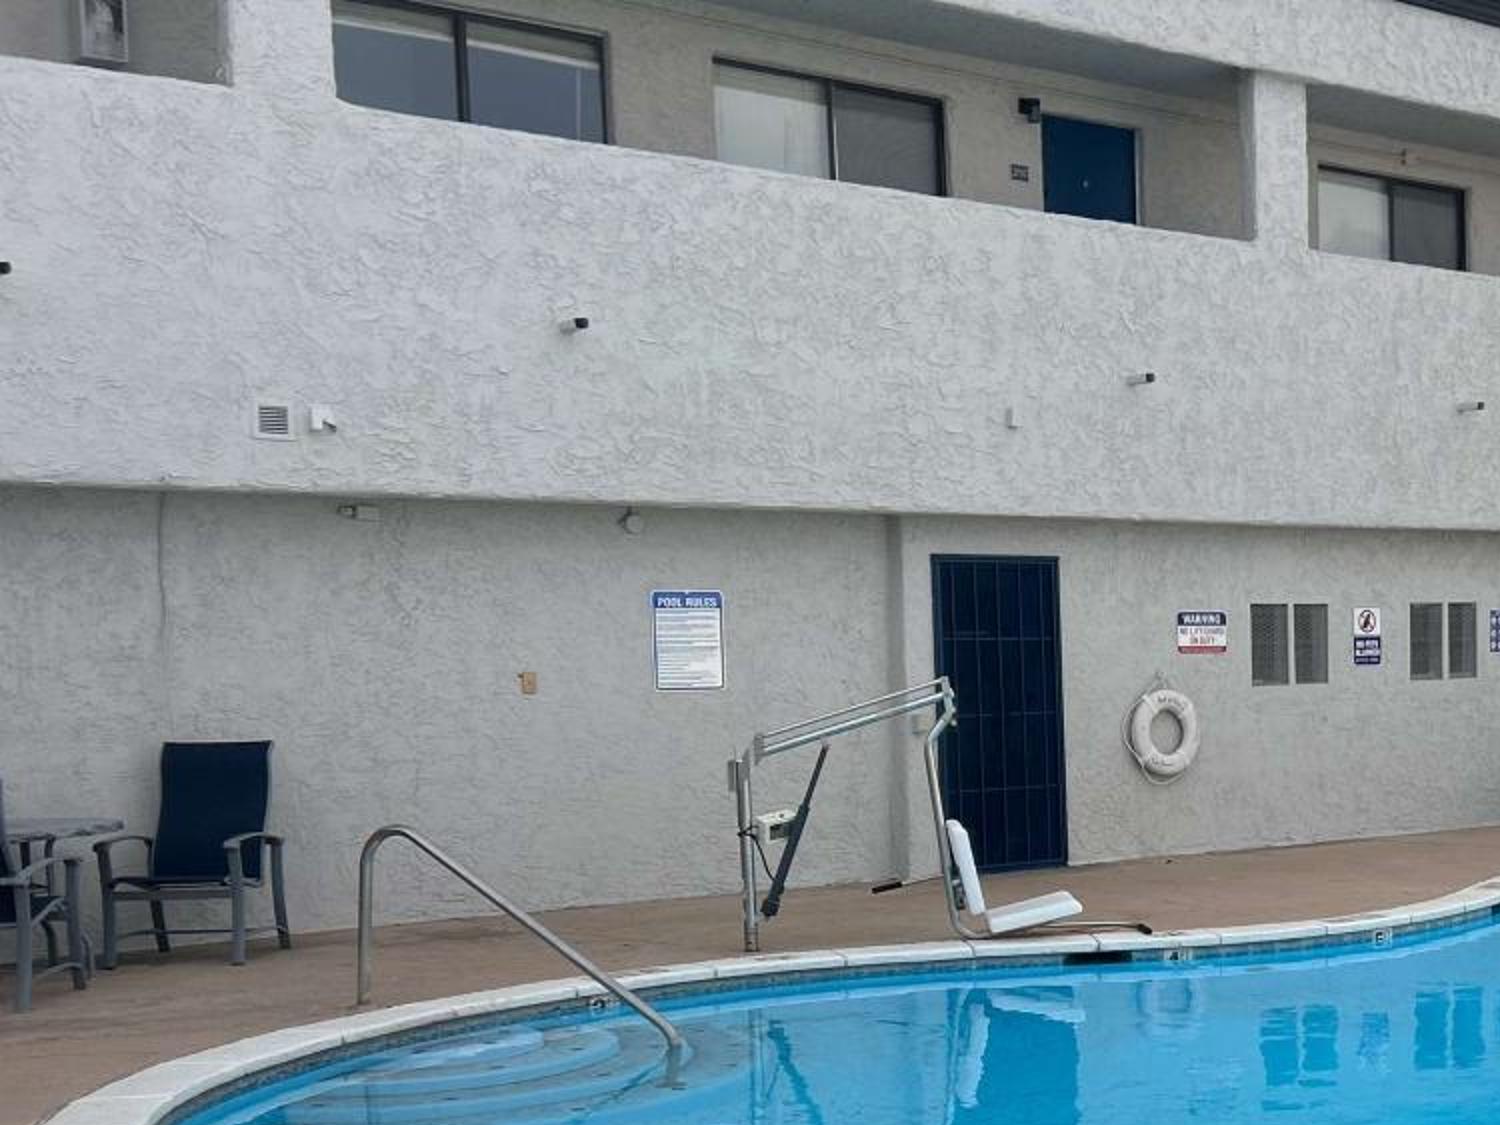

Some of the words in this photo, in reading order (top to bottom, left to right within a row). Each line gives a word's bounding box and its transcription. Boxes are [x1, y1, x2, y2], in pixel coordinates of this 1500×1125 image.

[657, 597, 681, 607] POOL
[685, 597, 717, 607] RULES
[1181, 613, 1221, 625] WARNING
